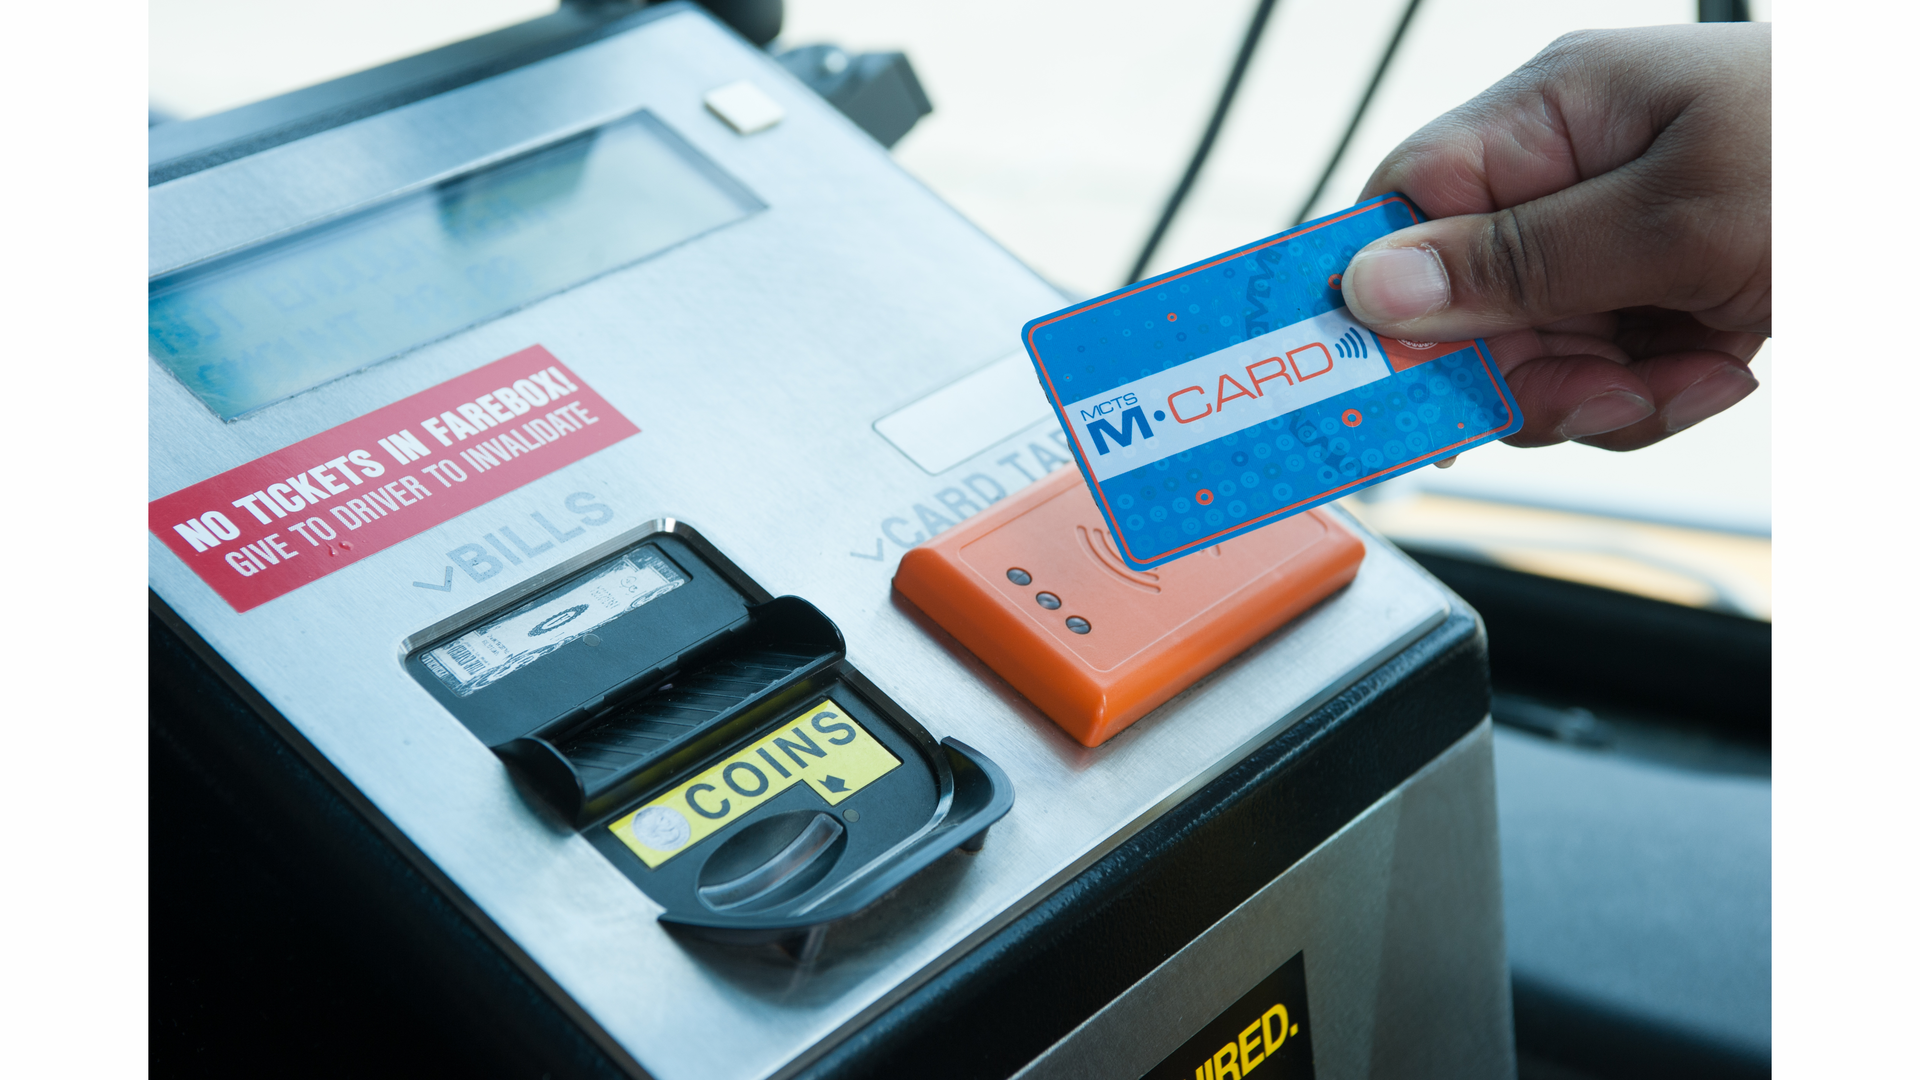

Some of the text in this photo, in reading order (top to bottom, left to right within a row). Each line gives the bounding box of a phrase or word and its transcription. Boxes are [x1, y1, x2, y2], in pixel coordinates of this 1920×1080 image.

[1080, 392, 1138, 422] MCTS
[173, 366, 579, 553] NO TICKETS IN FAREBOX!
[224, 400, 599, 578] GIVE TO DRIVER TO INVALIDATE
[446, 491, 614, 583] BILLS
[881, 472, 1007, 550] CARD
[684, 711, 857, 820] COINS
